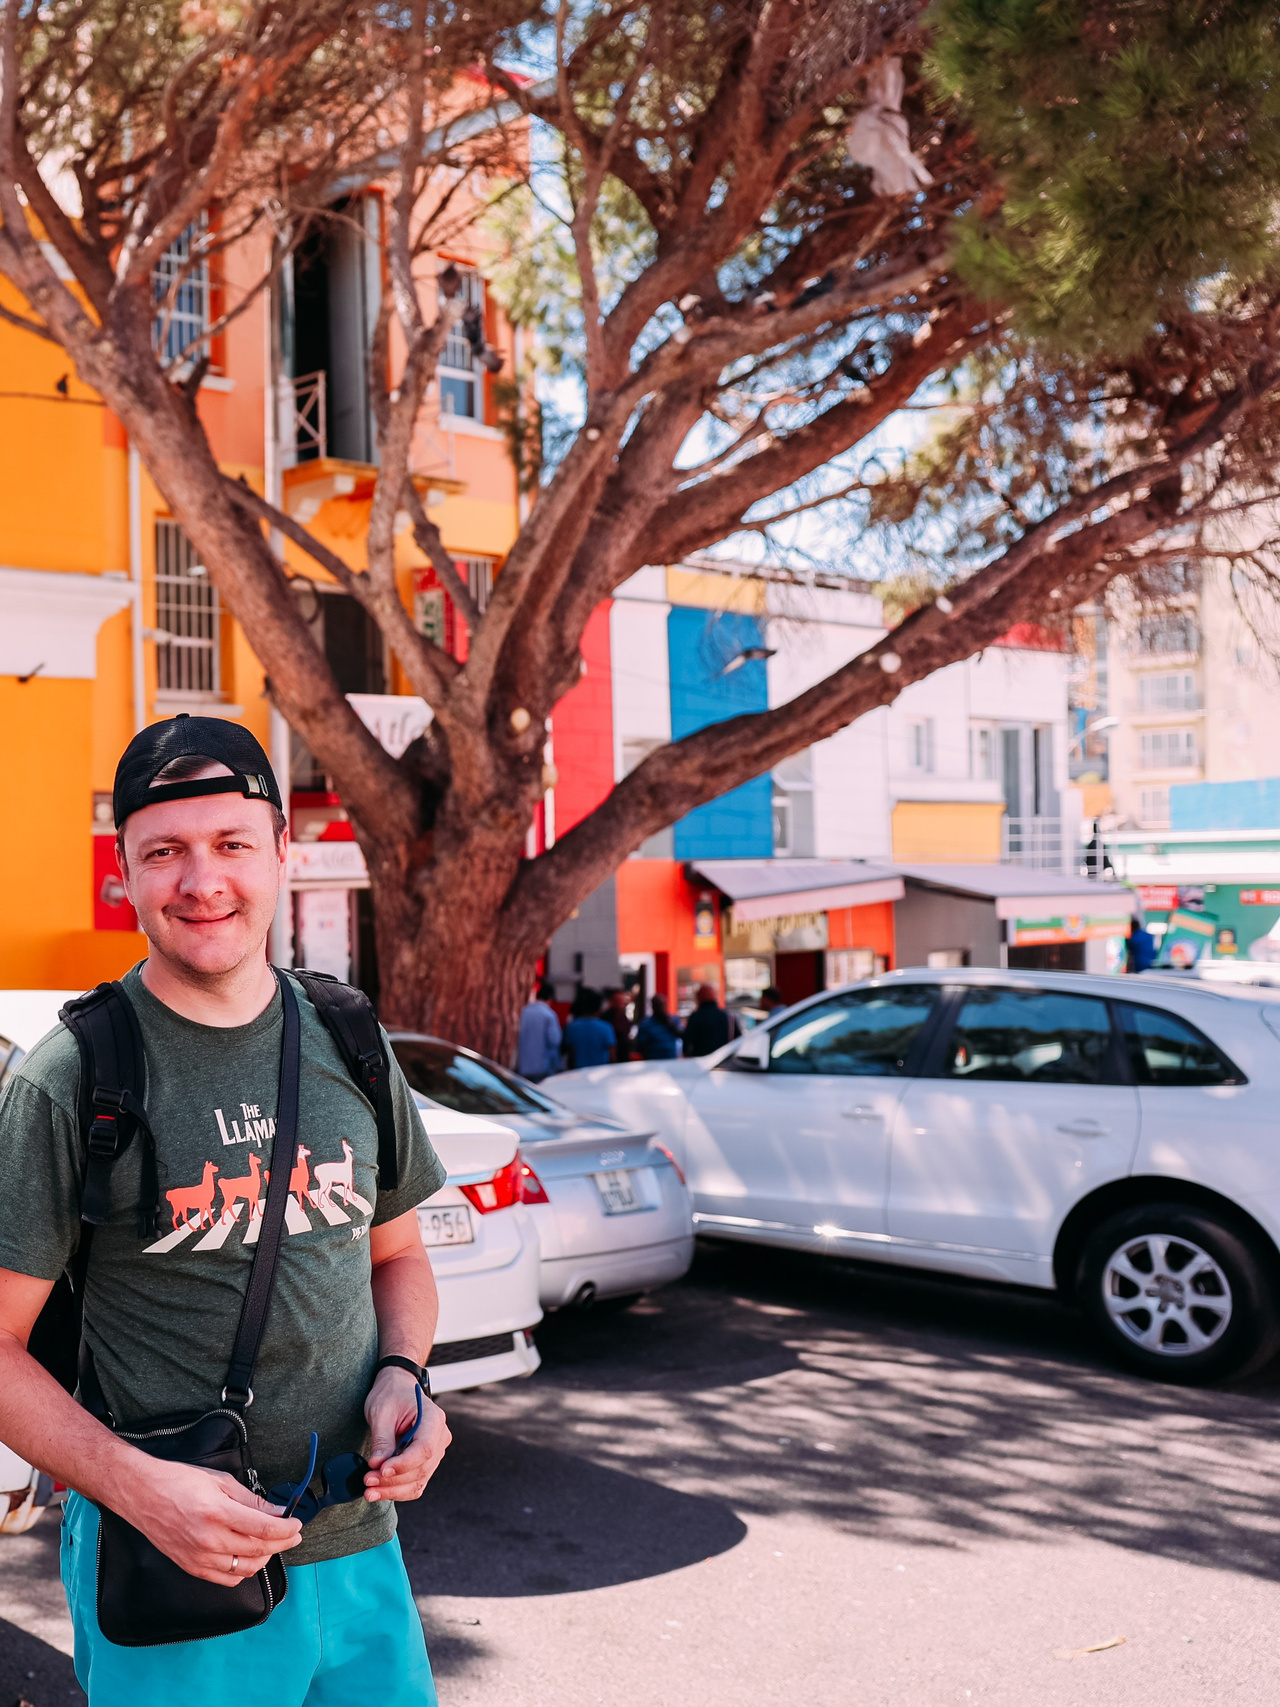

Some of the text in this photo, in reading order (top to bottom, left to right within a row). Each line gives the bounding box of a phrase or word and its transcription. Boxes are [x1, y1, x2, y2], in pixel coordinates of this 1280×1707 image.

[239, 1103, 262, 1120] THE
[213, 1108, 278, 1148] LLAMA
[418, 1210, 467, 1240] -956
